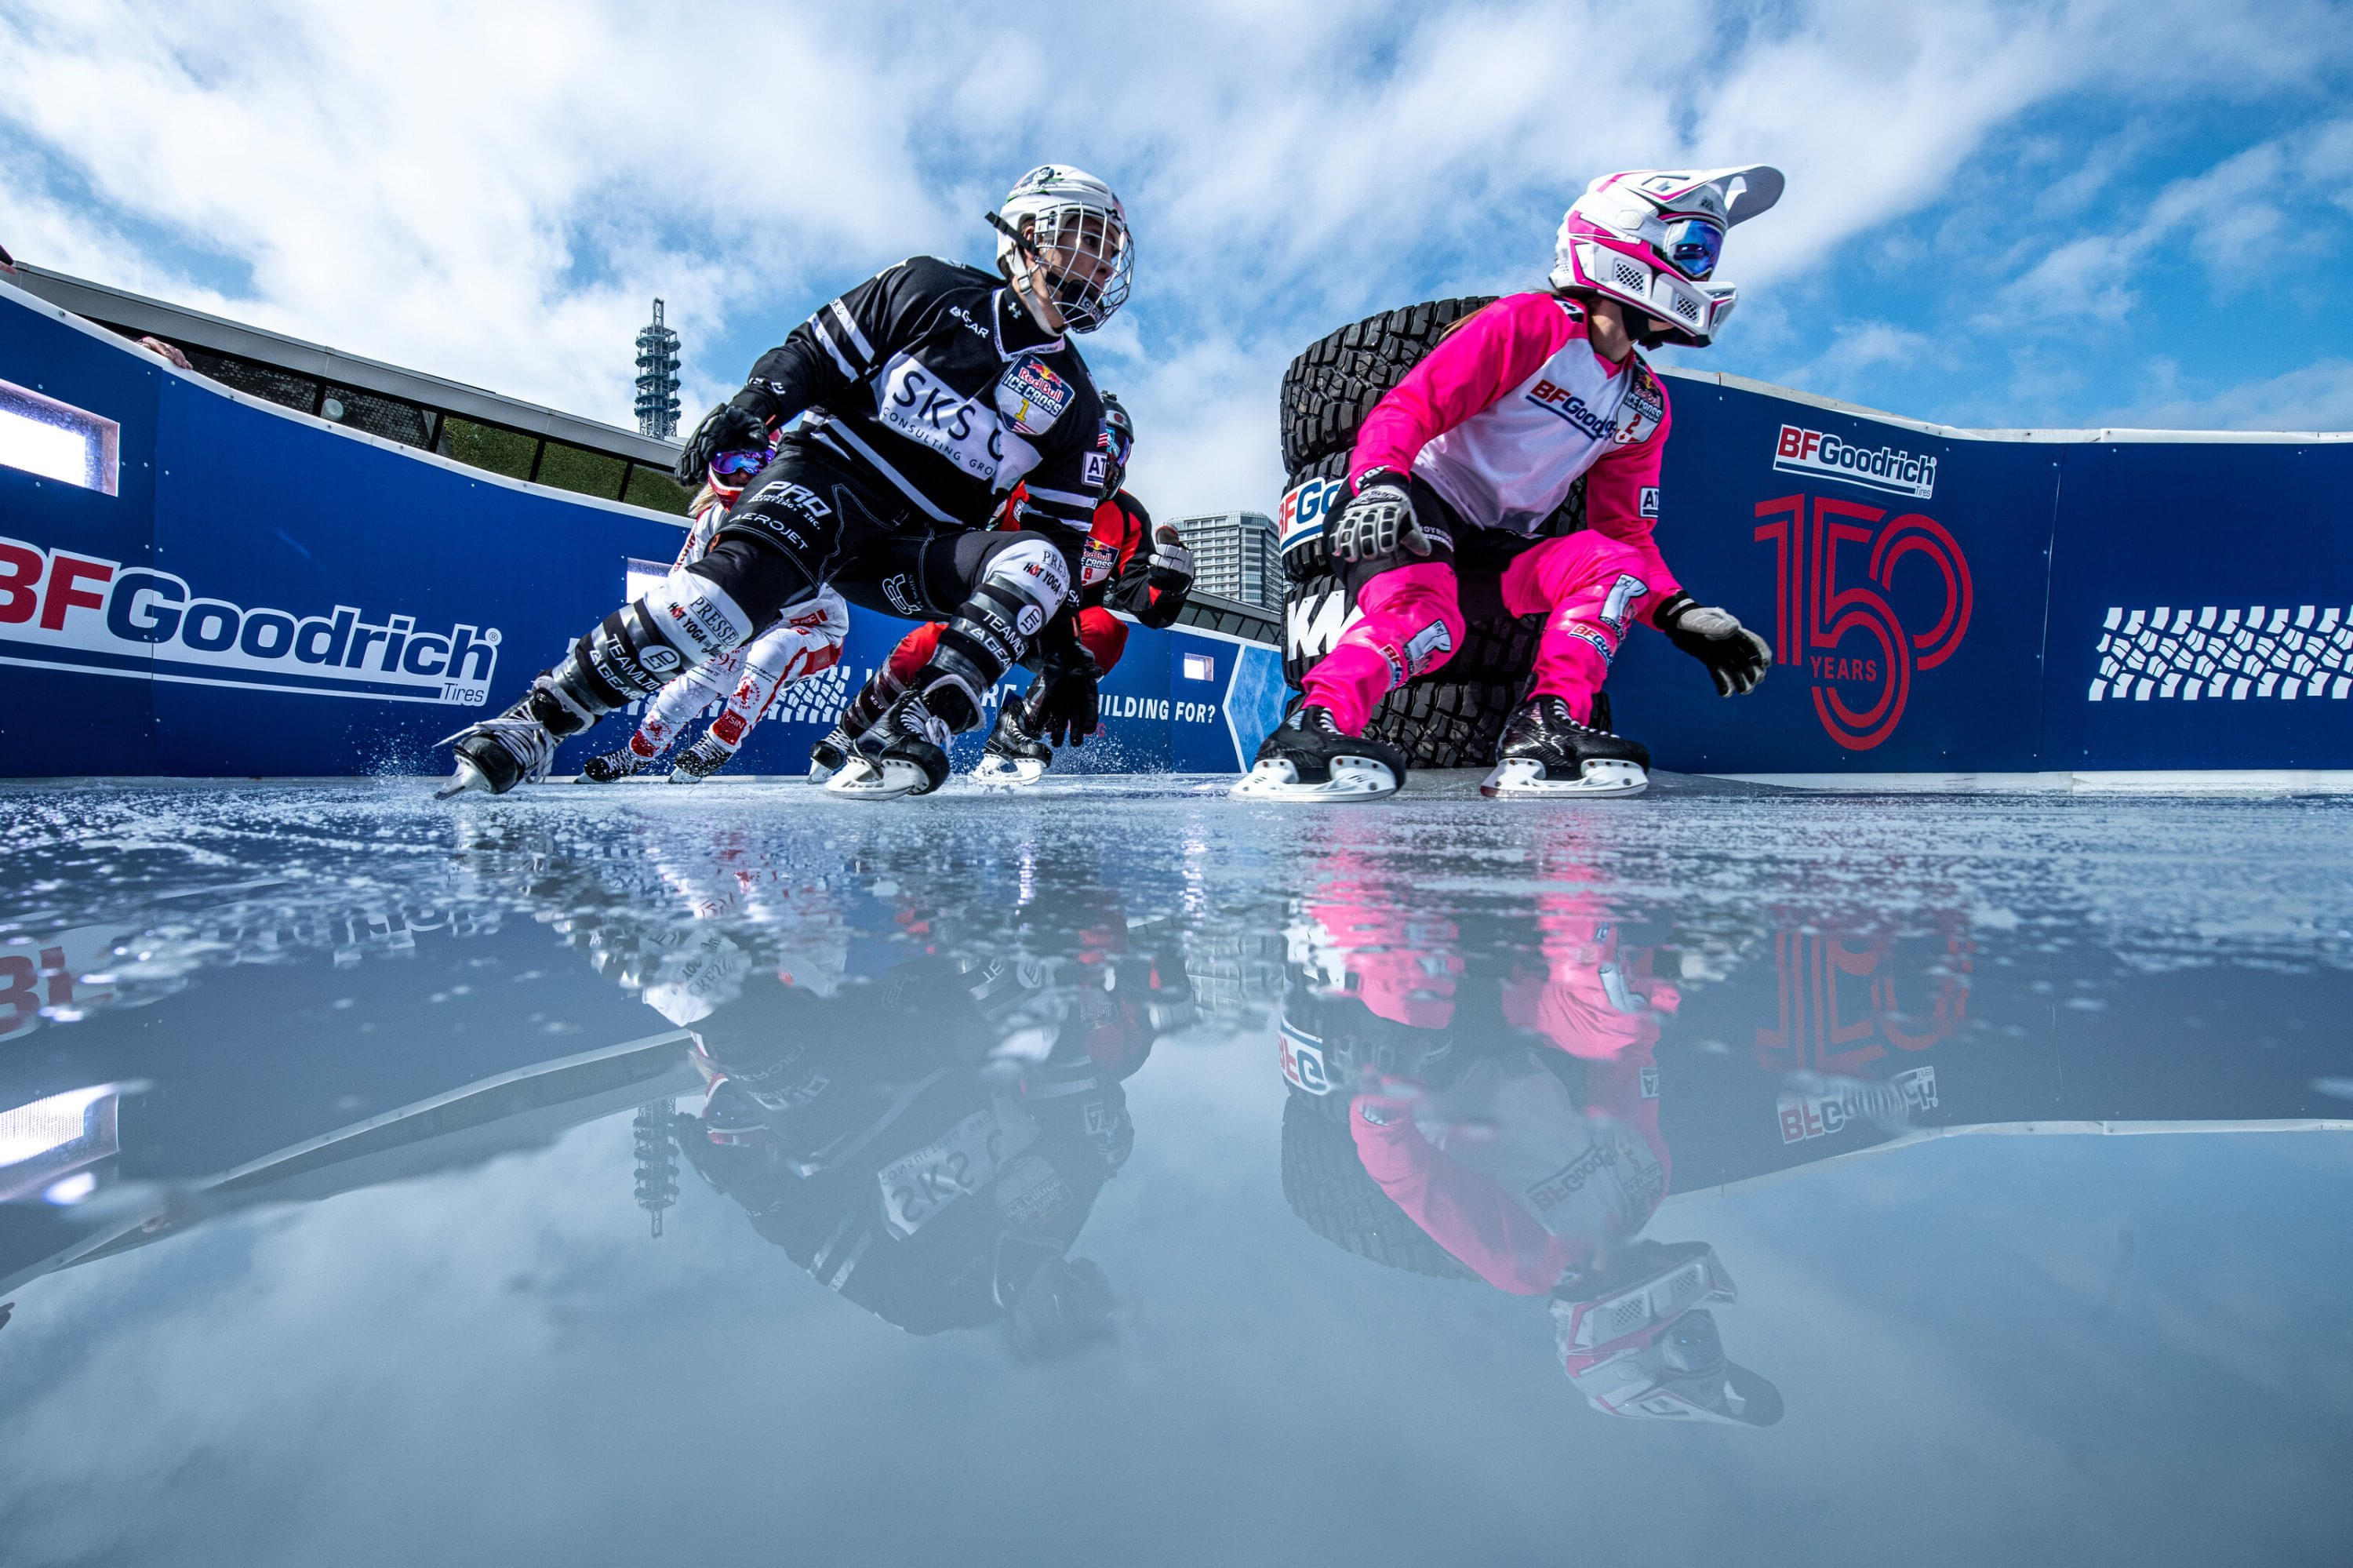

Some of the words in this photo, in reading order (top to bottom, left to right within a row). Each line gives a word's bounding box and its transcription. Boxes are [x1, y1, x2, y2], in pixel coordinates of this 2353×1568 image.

[1004, 373, 1027, 393] ICE
[1023, 384, 1062, 417] CROSS
[1018, 366, 1042, 389] Red
[1040, 380, 1064, 402] Bull
[1014, 398, 1030, 423] 1
[1624, 392, 1640, 407] ICE
[1637, 399, 1662, 422] CROSS
[1625, 413, 1642, 435] 2
[882, 406, 962, 461] CONSULTING
[969, 459, 993, 475] GRO
[1777, 427, 1936, 486] BFGoodrich
[747, 481, 832, 518] PRO
[1643, 490, 1658, 508] A
[1915, 486, 1931, 497] Tires
[729, 512, 809, 550] AEROJET
[803, 512, 820, 530] INC.
[1084, 567, 1093, 580] 8
[1085, 558, 1113, 569] CROSS
[1042, 571, 1062, 594] YOGA
[682, 617, 707, 643] YOGA
[1755, 493, 1973, 751] 150
[605, 633, 662, 690] TEAMLTD
[1810, 656, 1877, 682] YEARS
[443, 682, 485, 703] Tires
[1174, 702, 1216, 723] FOR?
